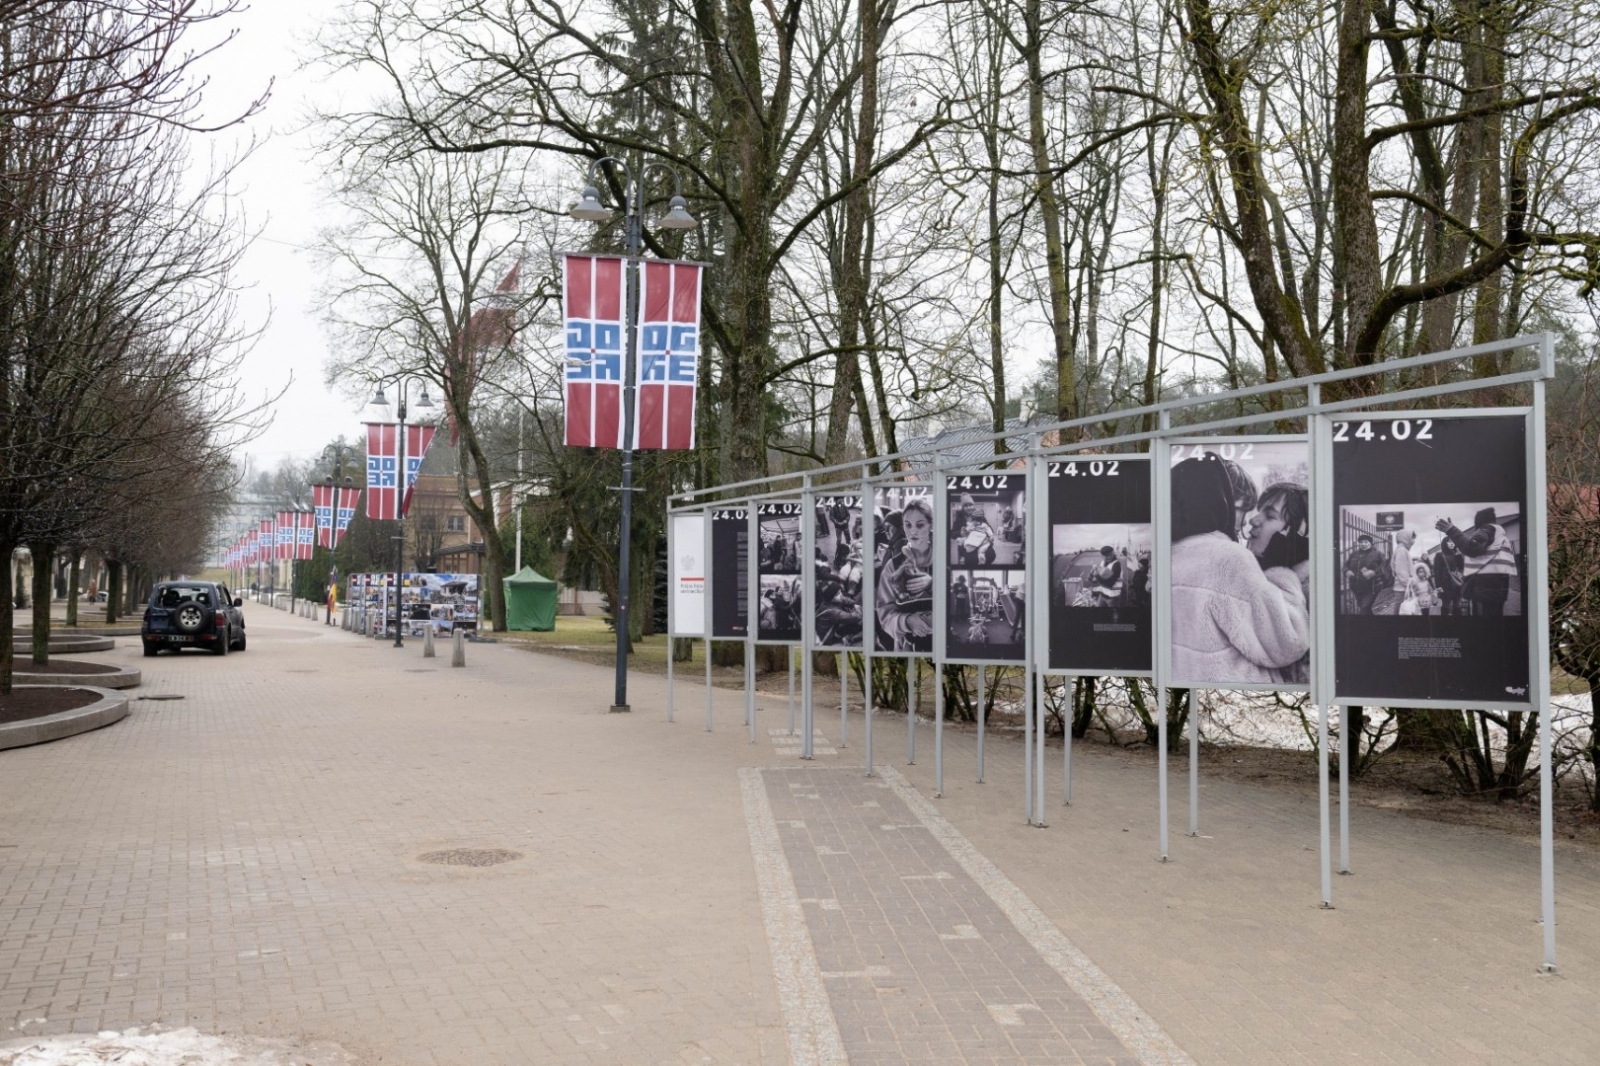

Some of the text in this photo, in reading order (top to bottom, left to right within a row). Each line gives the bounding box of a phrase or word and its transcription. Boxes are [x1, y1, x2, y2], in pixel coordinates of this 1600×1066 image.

[1333, 419, 1433, 442] 24.02
[1171, 443, 1254, 461] 24.02
[1048, 460, 1119, 478] 24.02
[947, 475, 1008, 490] 24.02
[874, 486, 927, 500] 24.02
[757, 503, 801, 515] 24.02
[815, 496, 862, 508] 24.02
